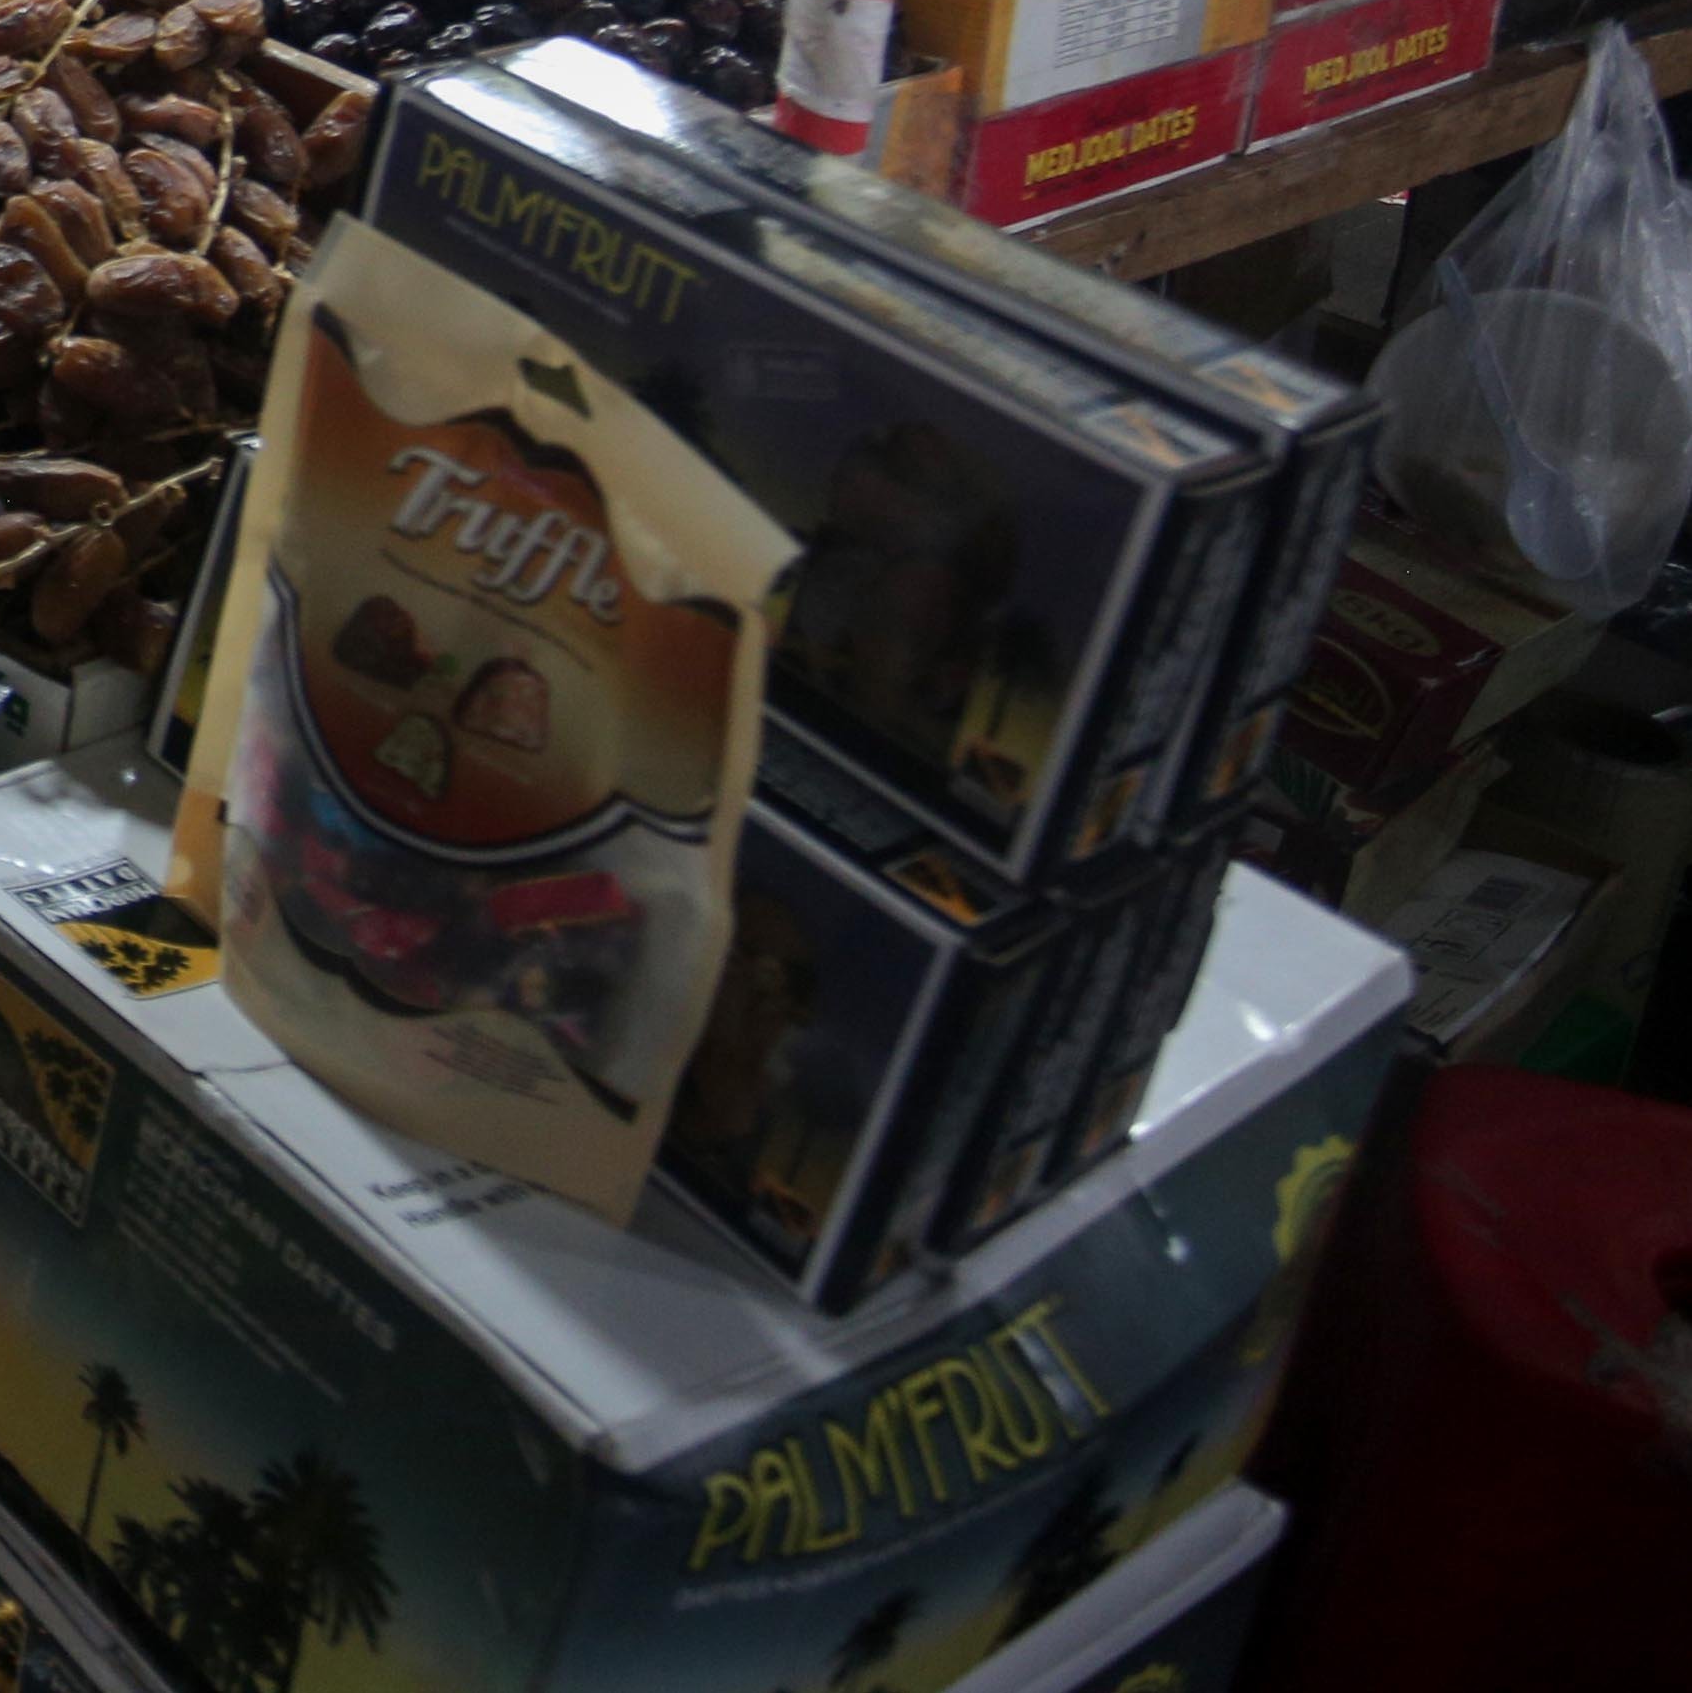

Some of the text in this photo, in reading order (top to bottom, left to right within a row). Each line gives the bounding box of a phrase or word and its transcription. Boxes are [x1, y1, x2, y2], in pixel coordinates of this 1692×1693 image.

[1025, 106, 1198, 185] MEDJOOL DATES
[1304, 24, 1449, 94] MEDJOOL DATES
[419, 135, 707, 324] PALM'FRUTT
[390, 445, 624, 627] Truffle
[689, 1301, 1112, 1570] PALM'FRUTT
